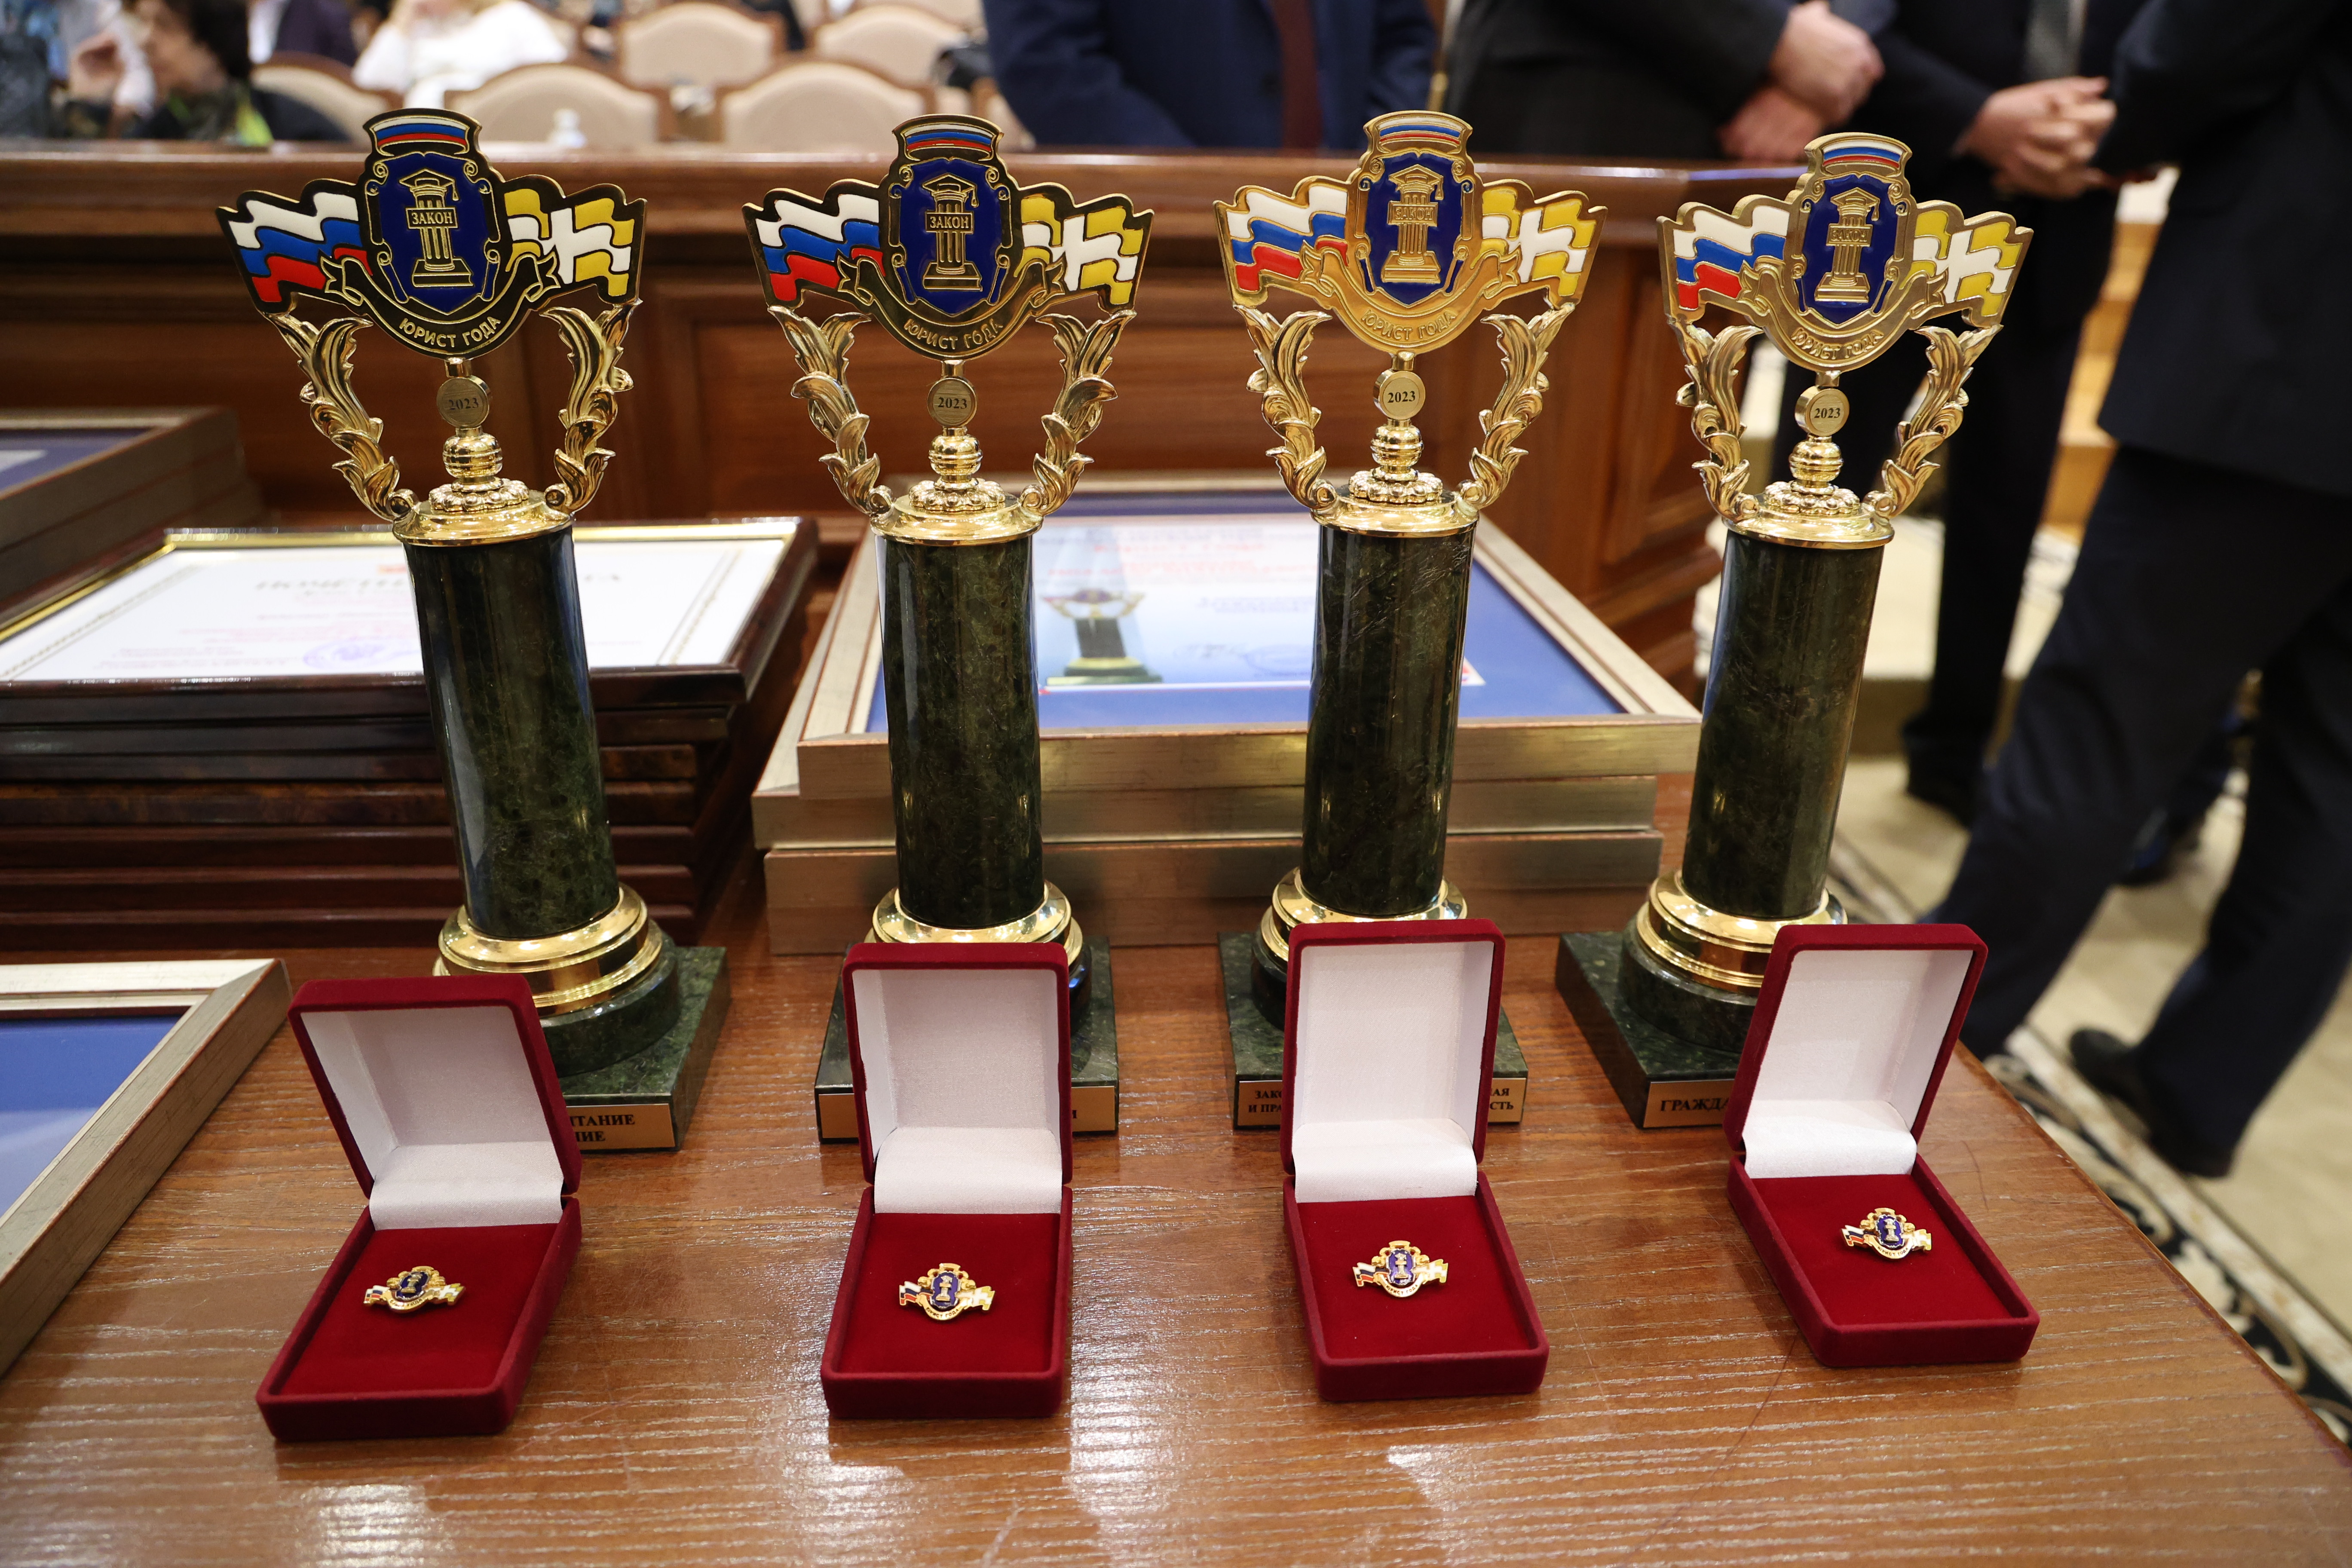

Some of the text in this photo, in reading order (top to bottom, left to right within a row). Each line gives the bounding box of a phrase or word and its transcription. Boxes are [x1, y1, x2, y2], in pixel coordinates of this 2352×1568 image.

[411, 211, 453, 225] ЗАКОН
[1395, 207, 1433, 220] ЗАКОН
[929, 215, 969, 229] ЗАКОН
[1361, 308, 1457, 340] ЮРИСТ ГОДА
[399, 316, 502, 348] ЮРИСТ ГОДА
[903, 318, 1004, 350] ЮРИСТ ГОДА
[1791, 327, 1885, 360] ЮРИСТ ГОДА
[448, 397, 479, 410] 2023
[937, 397, 968, 409] 2023
[1387, 390, 1416, 403] 2023
[1814, 407, 1841, 419] 2023
